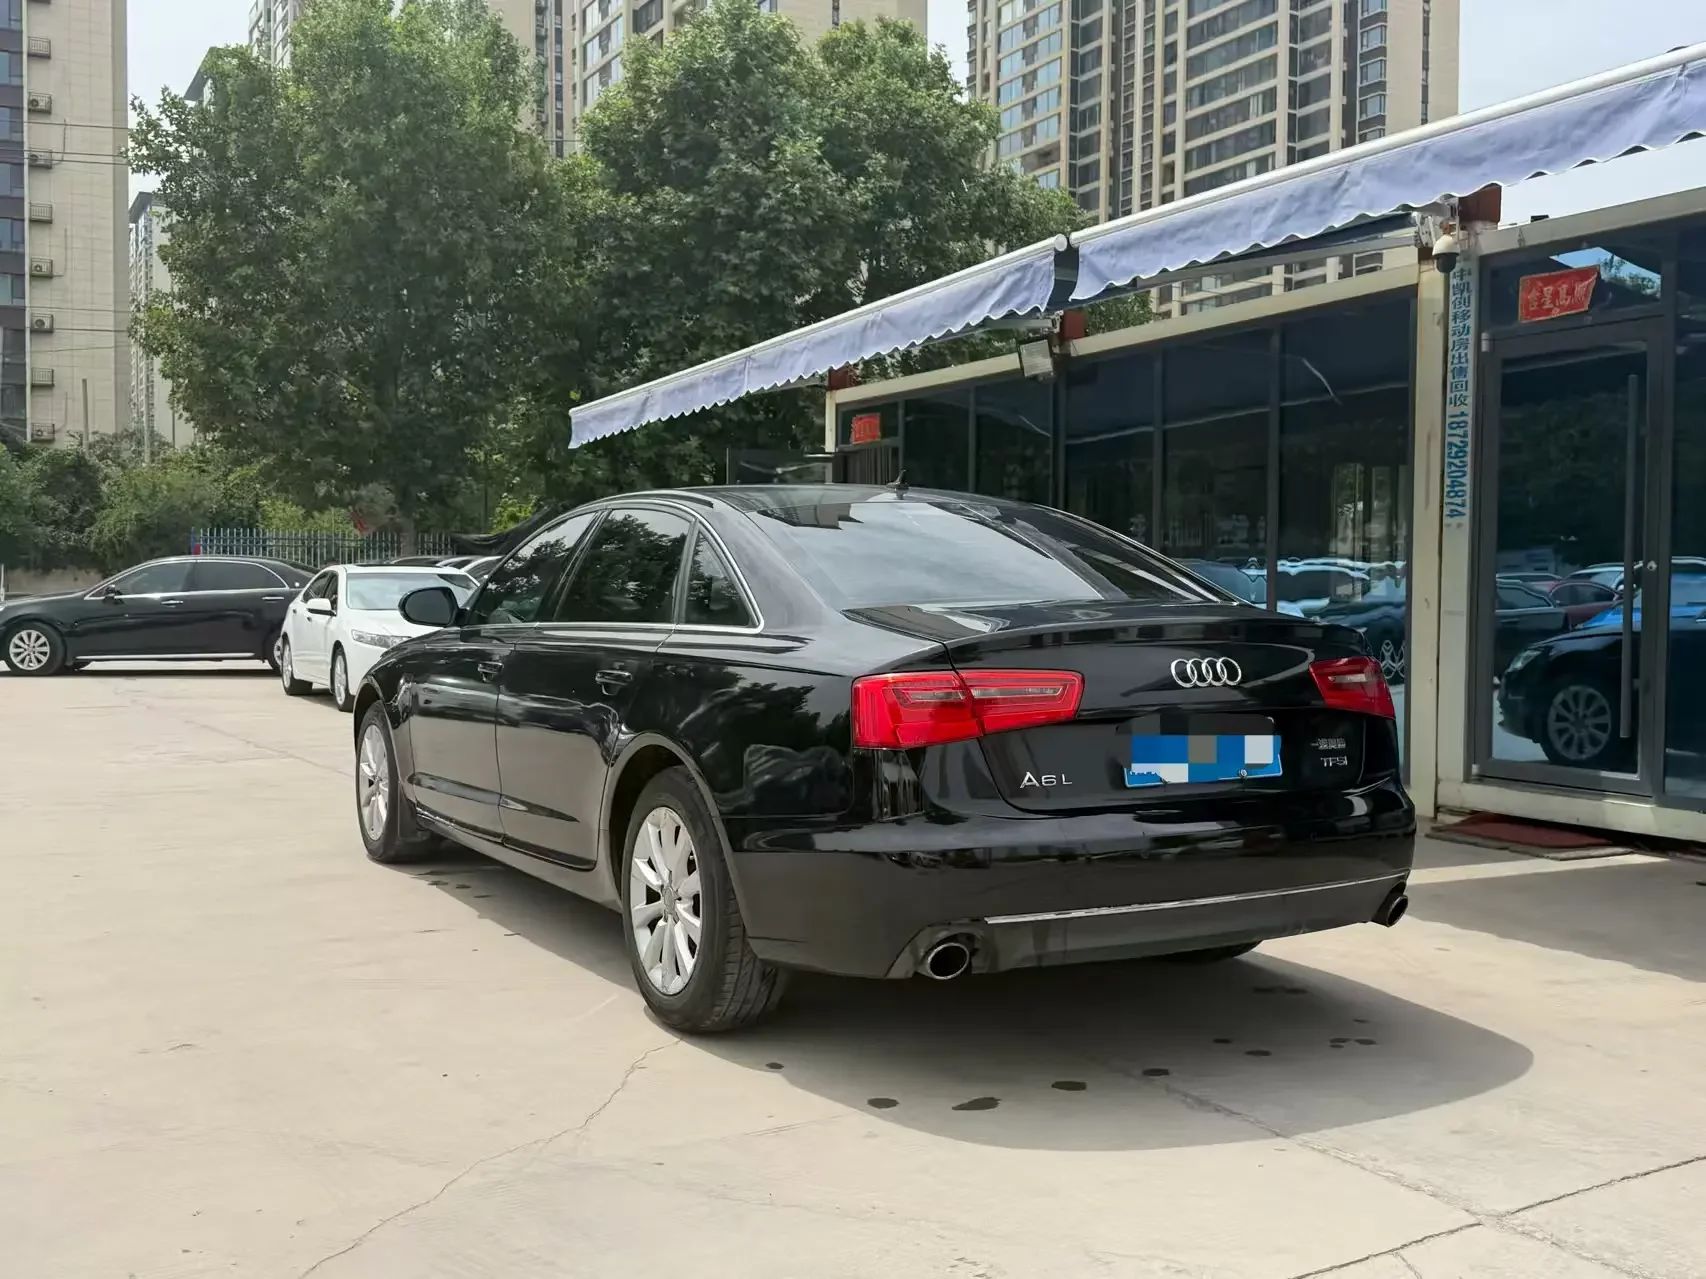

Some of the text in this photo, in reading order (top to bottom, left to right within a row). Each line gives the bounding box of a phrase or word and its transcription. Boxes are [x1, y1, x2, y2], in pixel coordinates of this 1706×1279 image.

[1445, 411, 1469, 519] 18729204874
[1320, 755, 1348, 767] TFSI
[1019, 771, 1073, 789] A6L
